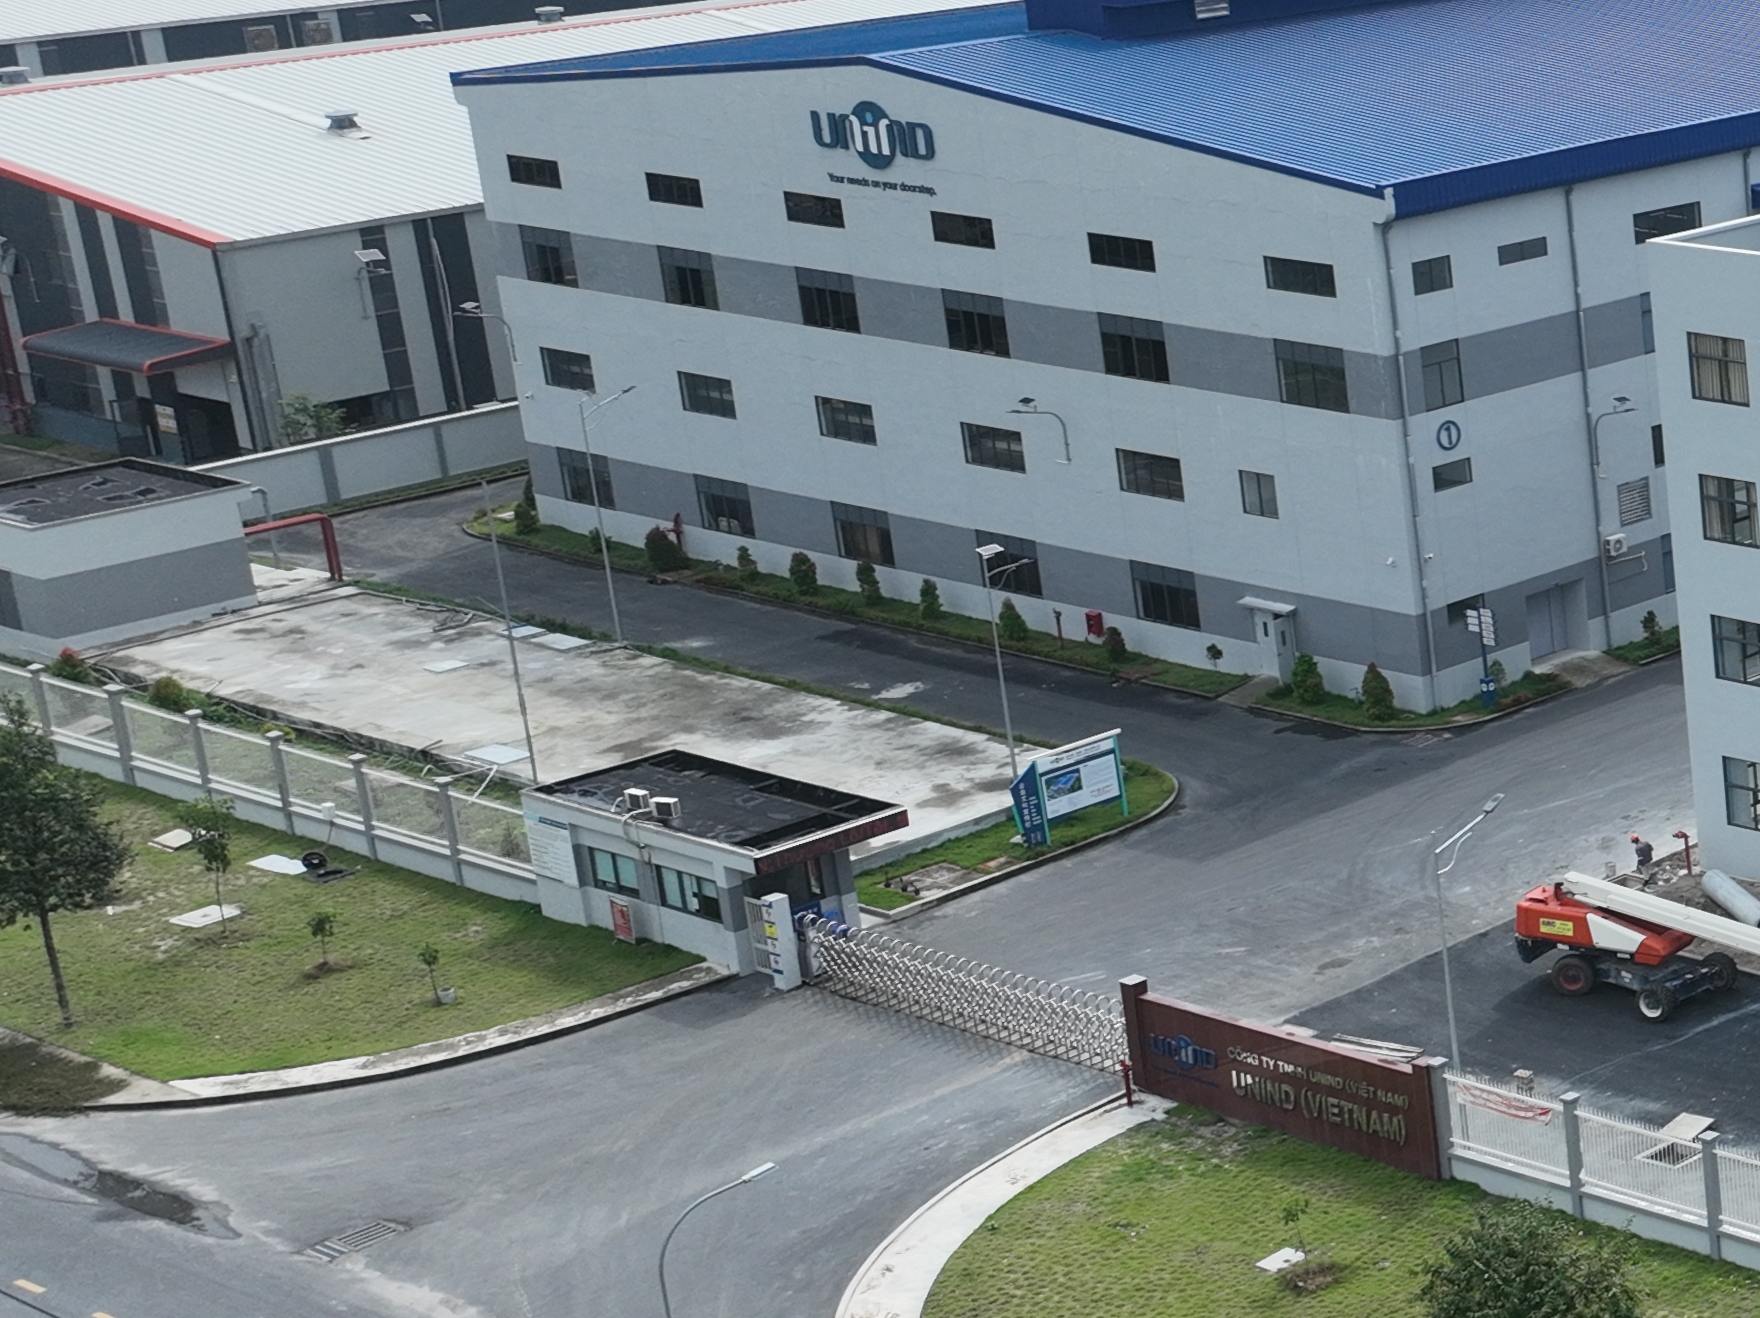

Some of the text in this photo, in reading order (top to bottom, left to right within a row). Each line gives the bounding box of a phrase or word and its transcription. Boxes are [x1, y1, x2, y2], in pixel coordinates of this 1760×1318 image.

[827, 172, 847, 185] Your
[847, 175, 870, 187] needs
[871, 179, 881, 188] on
[881, 180, 898, 192] your
[1227, 1045, 1259, 1066] CÔNG
[1260, 1055, 1275, 1070] TY
[1276, 1060, 1307, 1079] TNHH
[1308, 1069, 1343, 1089] UNIND
[1376, 1088, 1409, 1110] NAM)
[1231, 1070, 1295, 1110] UNIND
[1301, 1086, 1407, 1147] (VIETNAM)
